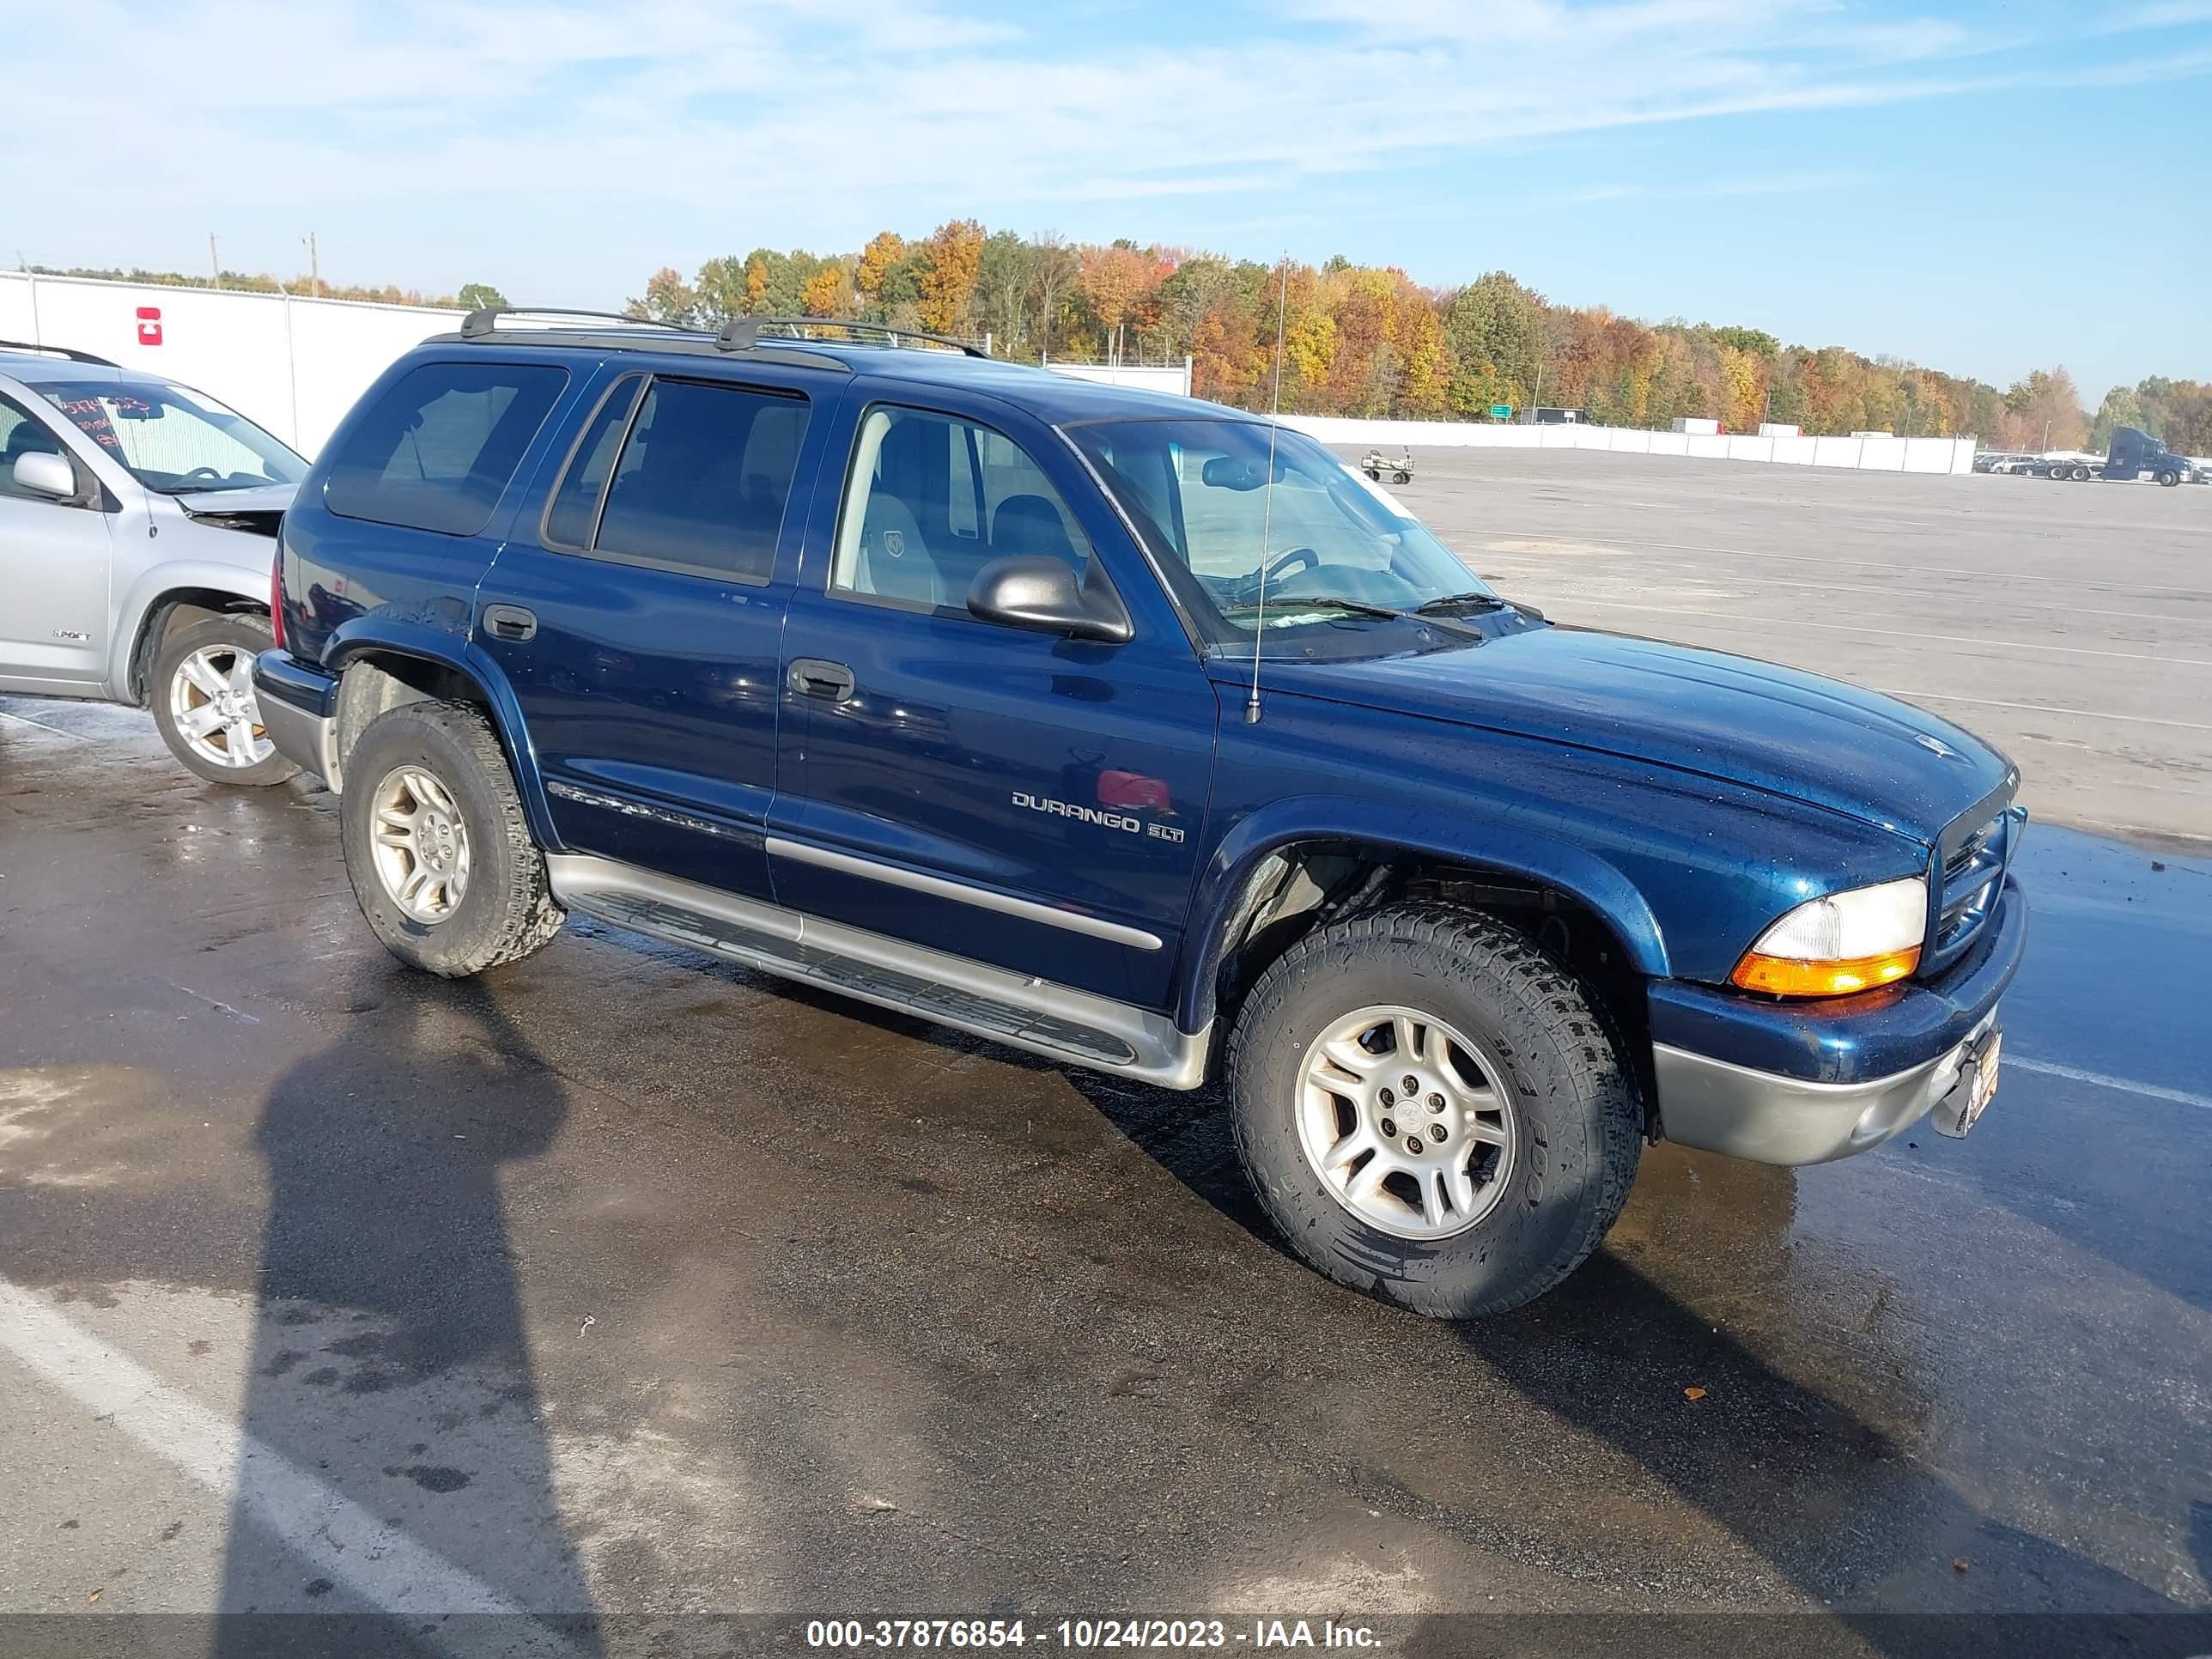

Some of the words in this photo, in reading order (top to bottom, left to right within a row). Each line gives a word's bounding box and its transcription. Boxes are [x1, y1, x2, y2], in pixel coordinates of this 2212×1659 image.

[52, 629, 92, 641] SPORT
[1012, 791, 1140, 834] DURANGO
[1147, 823, 1183, 843] SLT
